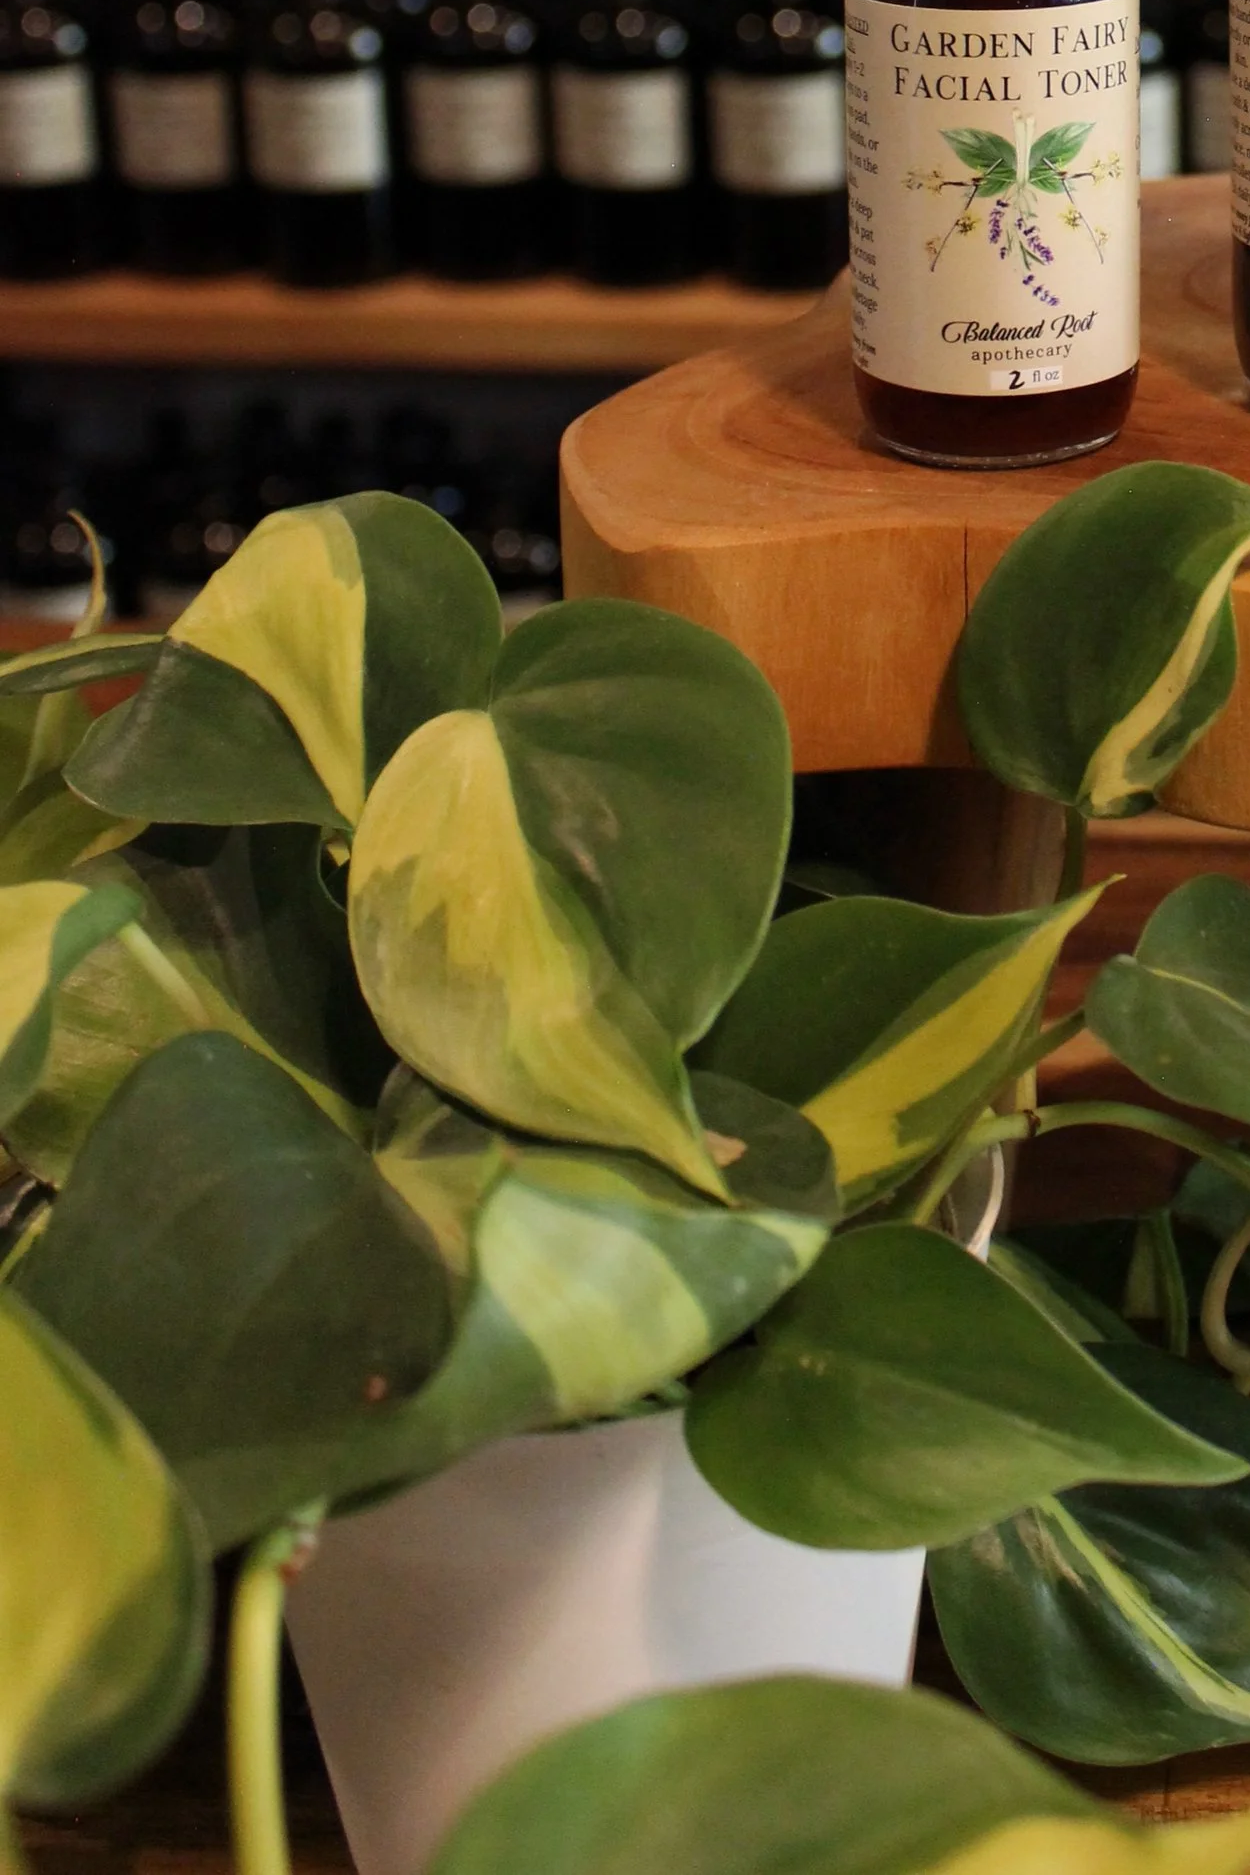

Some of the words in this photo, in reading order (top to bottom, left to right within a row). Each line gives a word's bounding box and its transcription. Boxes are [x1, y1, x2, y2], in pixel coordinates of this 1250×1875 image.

[868, 139, 879, 151] or
[941, 319, 1045, 344] Balanced
[1051, 310, 1098, 339] Root
[971, 343, 1073, 365] apothecary
[1008, 370, 1025, 390] 2
[1032, 370, 1041, 383] fl
[1045, 371, 1060, 381] oz
